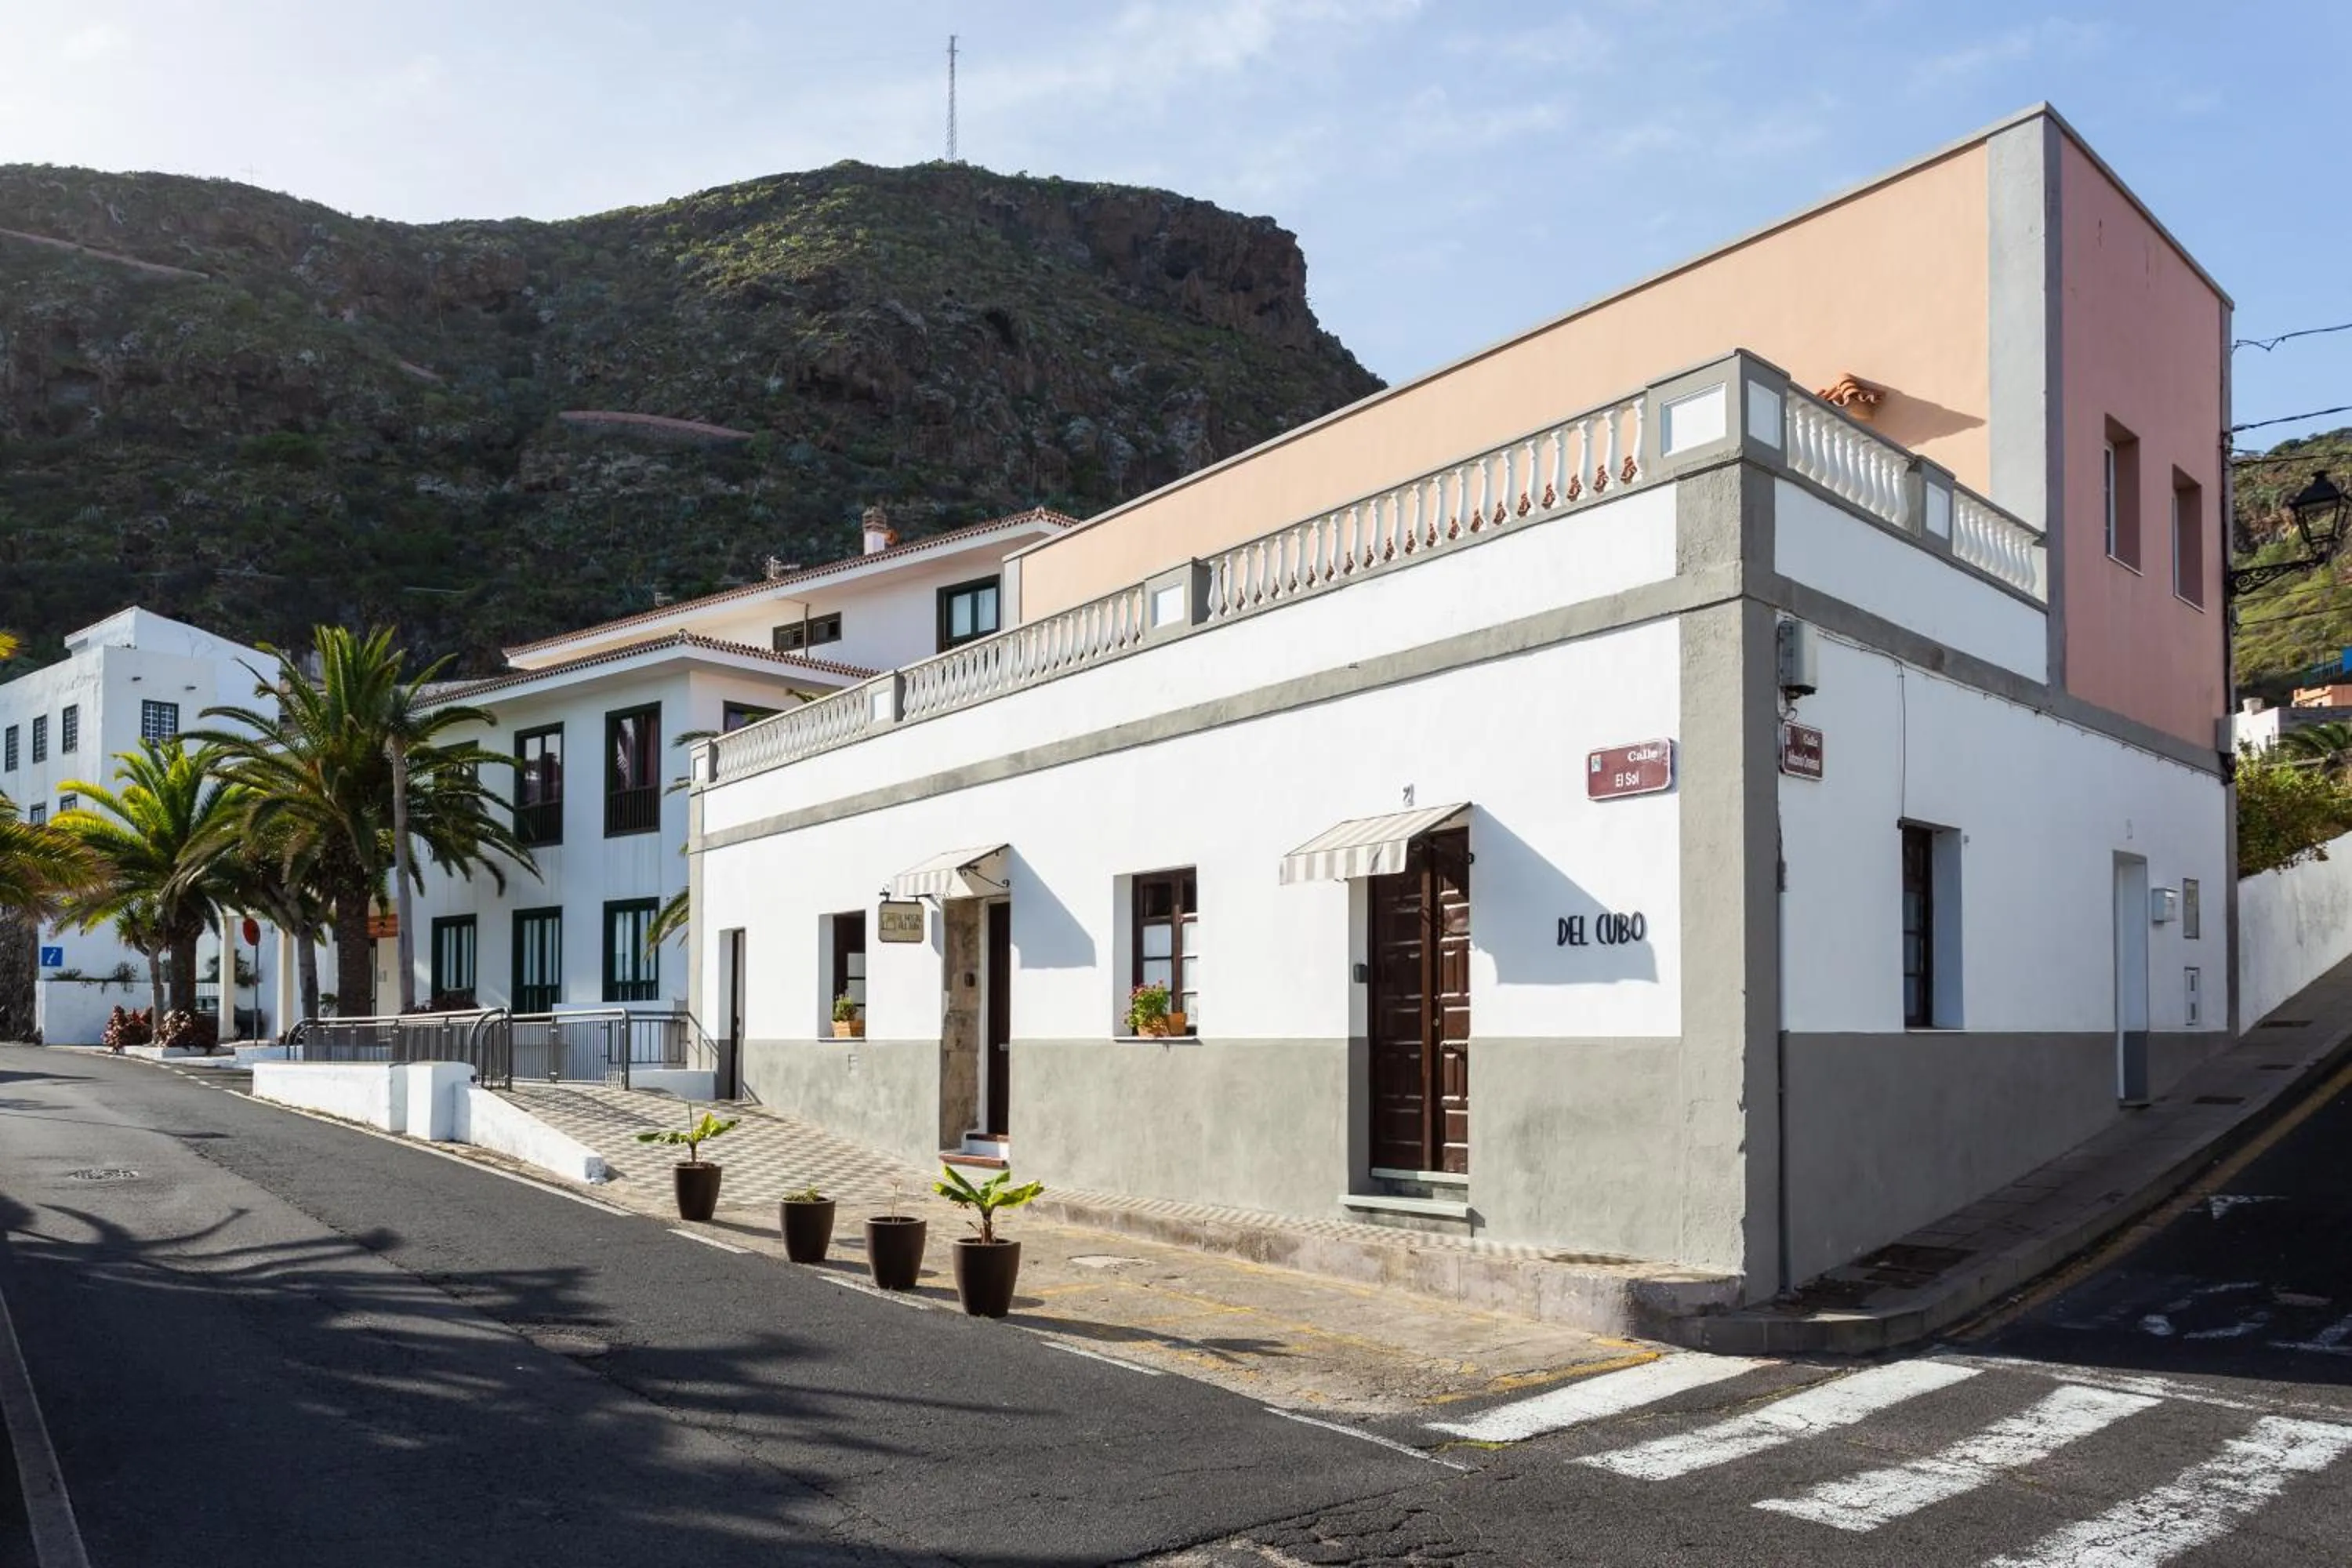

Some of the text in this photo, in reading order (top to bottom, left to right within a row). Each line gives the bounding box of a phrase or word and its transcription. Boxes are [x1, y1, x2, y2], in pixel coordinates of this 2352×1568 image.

[1628, 749, 1658, 762] Calle
[1615, 771, 1640, 788] El Sol
[1556, 911, 1645, 946] DEL CUBO
